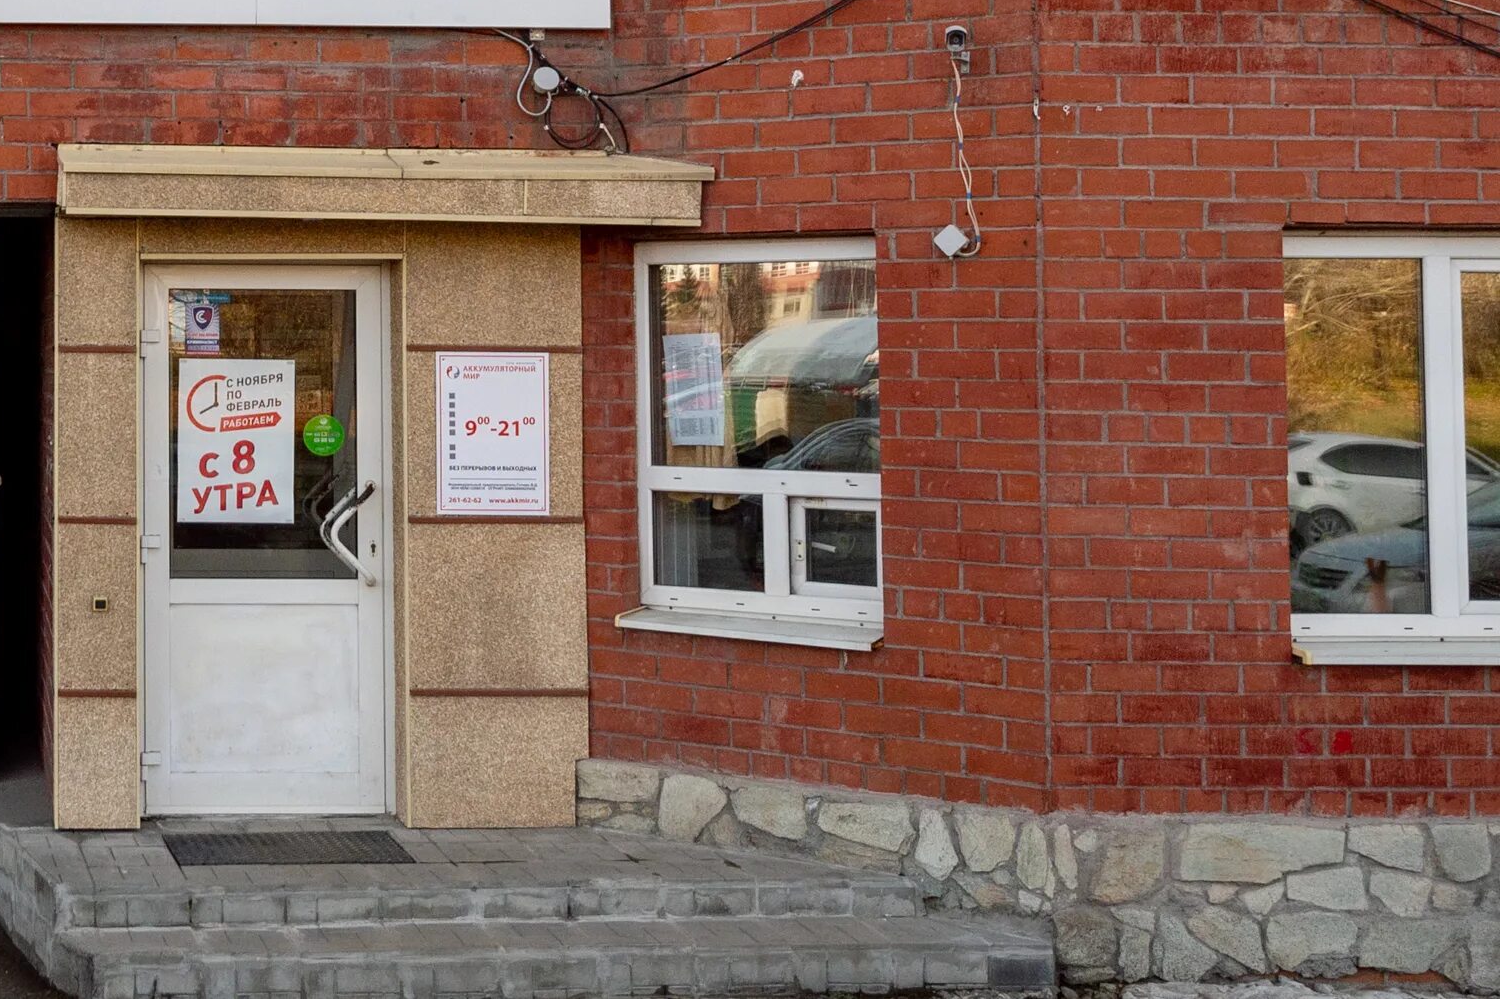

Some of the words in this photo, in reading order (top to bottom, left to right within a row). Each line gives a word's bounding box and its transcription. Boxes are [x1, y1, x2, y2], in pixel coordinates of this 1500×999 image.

[462, 365, 536, 373] АККУМУЛЯТОРНЫЙ
[226, 378, 233, 388] С
[236, 373, 284, 387] НОЯБРЯ
[226, 390, 242, 401] ПО
[226, 398, 282, 412] ФЕВРАЛЬ
[222, 415, 275, 429] РАБОТАЕМ
[232, 439, 256, 475] 8
[191, 479, 280, 515] УТРА
